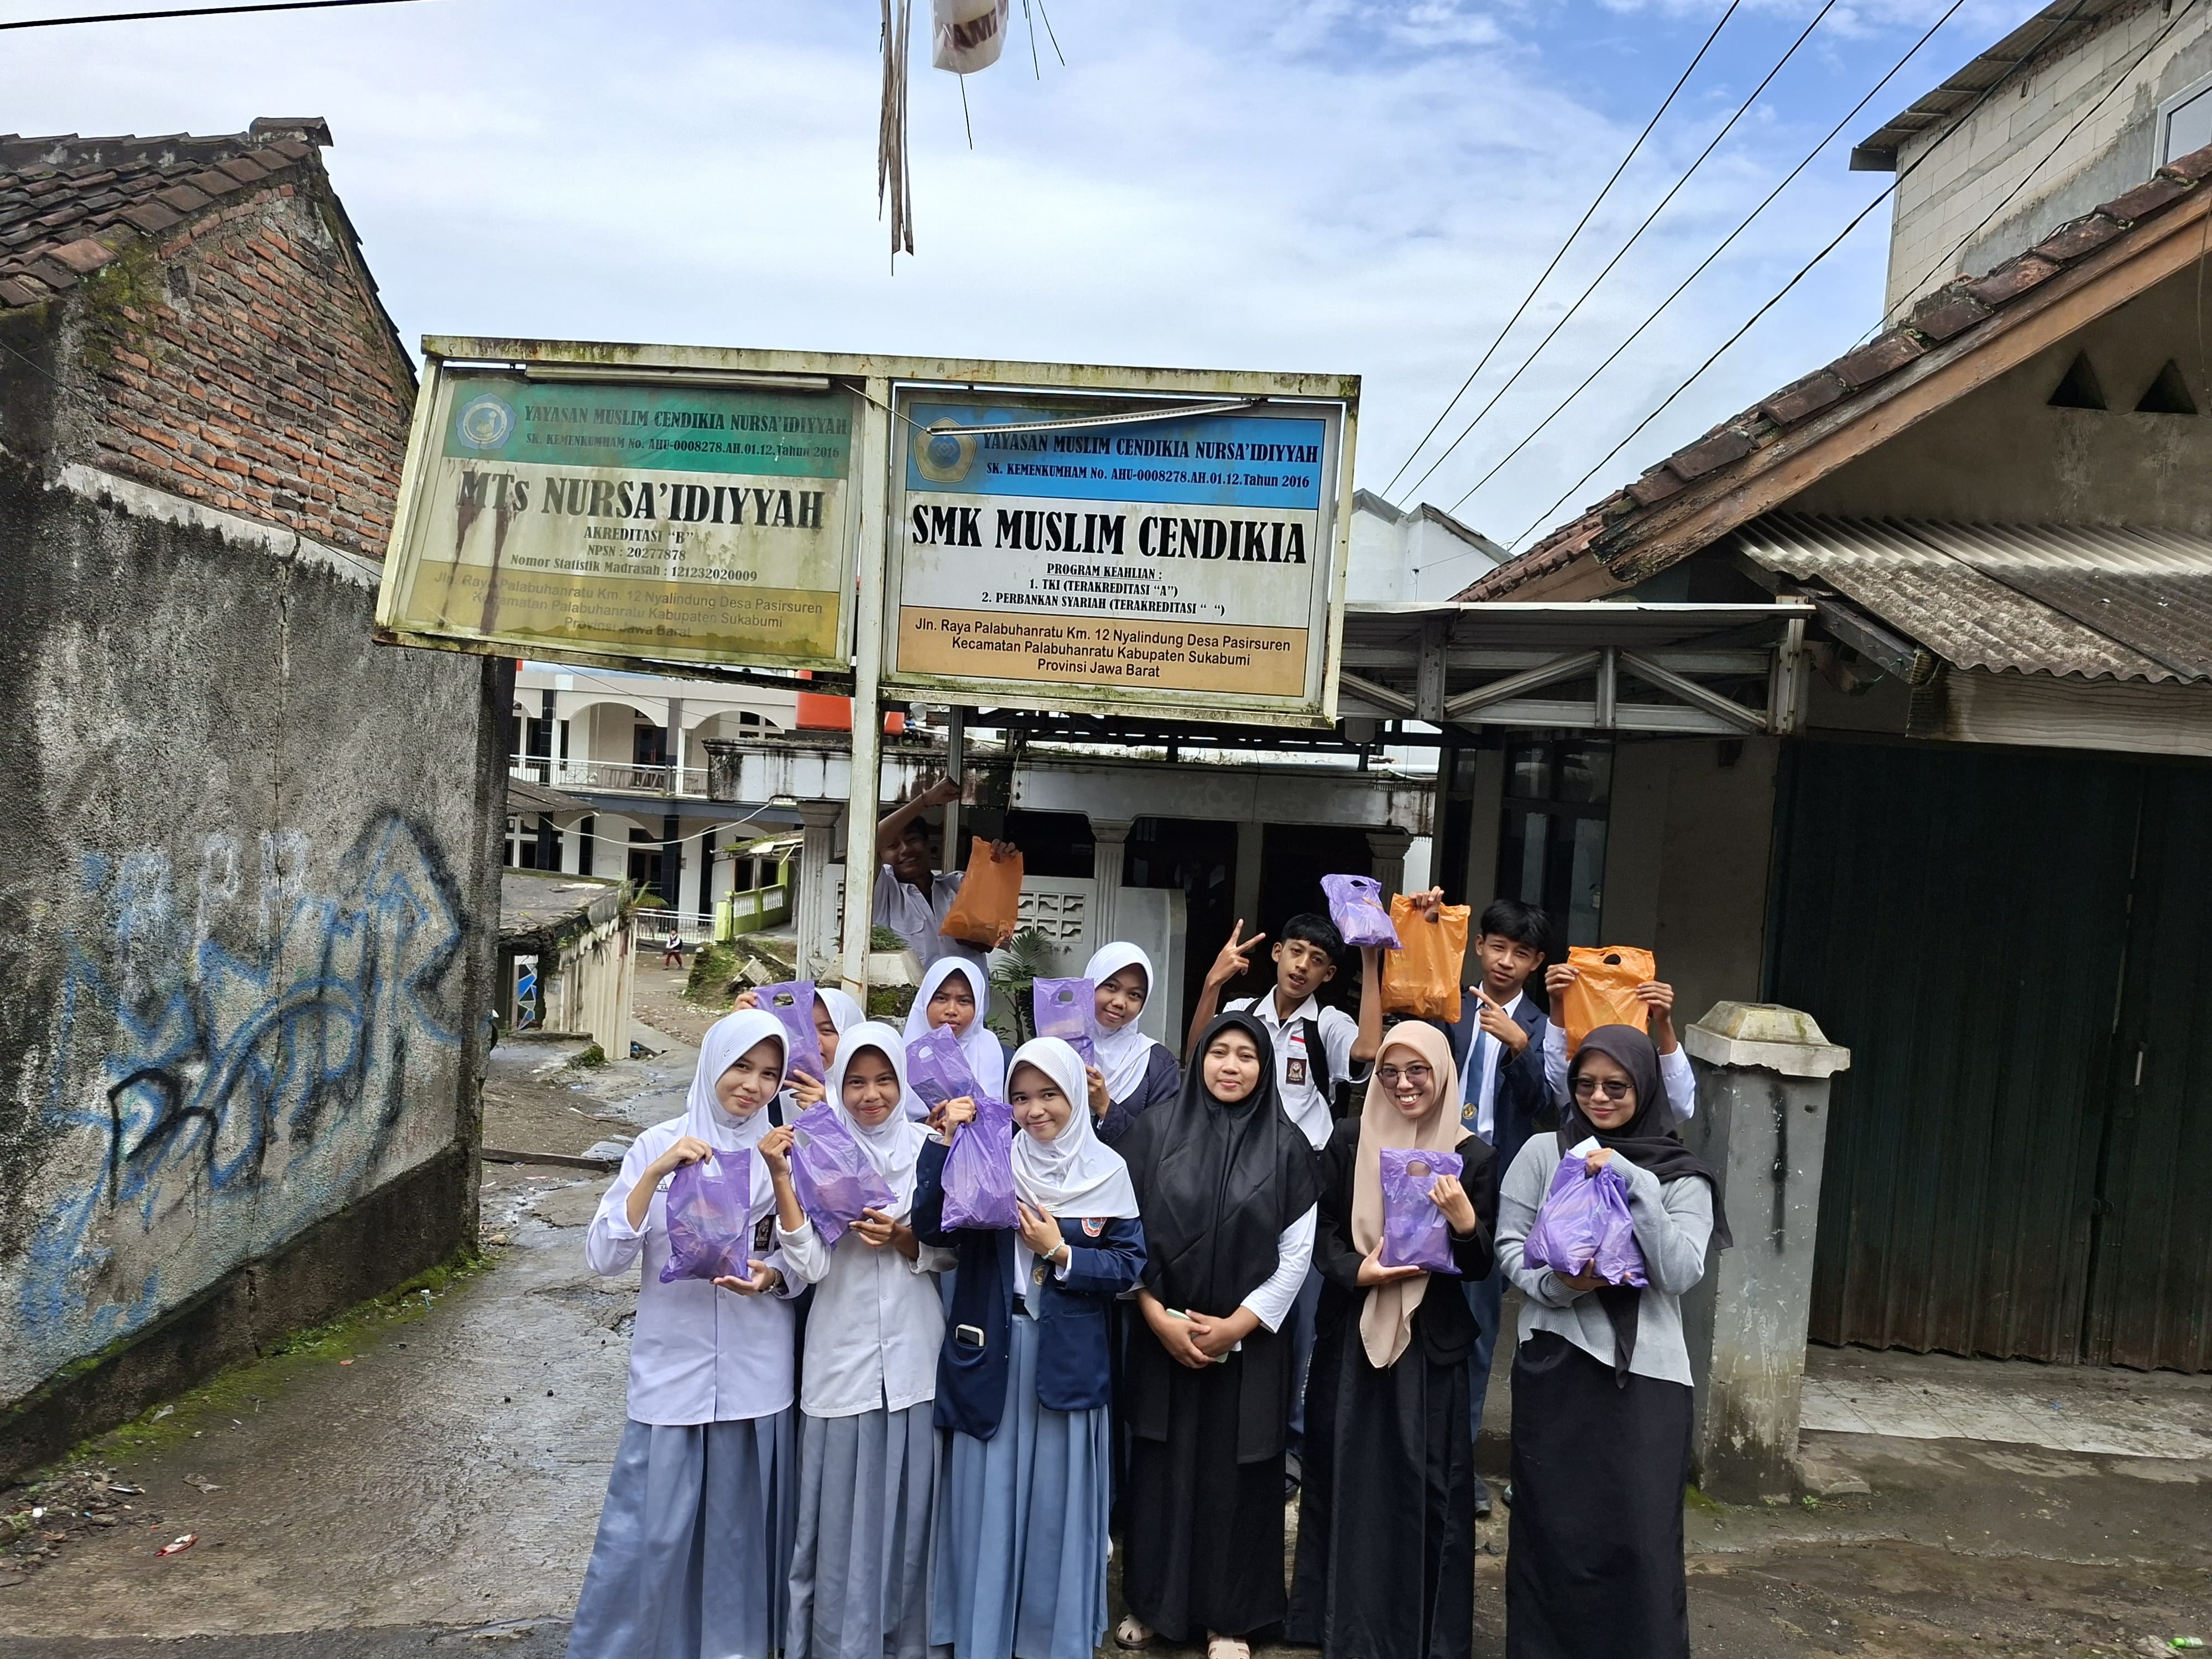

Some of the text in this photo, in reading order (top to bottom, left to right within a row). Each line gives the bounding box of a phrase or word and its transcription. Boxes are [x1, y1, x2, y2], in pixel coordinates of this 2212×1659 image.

[525, 405, 588, 424] YAYASAN
[592, 409, 649, 426] MUSLIM
[654, 411, 725, 430] CENDIKIA
[526, 433, 542, 444] SK.
[628, 438, 644, 449] No.
[814, 446, 839, 458] 2016
[983, 433, 1047, 452] YAYASAN
[1053, 435, 1111, 455] MUSLIM
[1116, 438, 1190, 458] CENDIKIA
[987, 462, 1003, 474] SK.
[1007, 463, 1087, 479] KEMENKUMHAM
[1090, 467, 1108, 479] No.
[1282, 476, 1310, 488] 2016
[457, 471, 529, 512] MTs
[584, 526, 662, 543] AKREDITASI
[912, 504, 1307, 564] SMK MUSLIM CENDIKIA
[587, 544, 615, 557] NPSN
[627, 547, 686, 561] 20277878
[510, 554, 550, 568] Nomor
[554, 557, 600, 572] Statistik
[604, 561, 660, 576] Madrasah
[671, 566, 758, 582] 121232020009
[1046, 563, 1100, 576] PROGRAM
[1104, 566, 1155, 580] KEAHLIAN
[500, 578, 593, 598] Palabuhanratu
[598, 587, 622, 601] Km.
[627, 591, 642, 602] 12
[645, 591, 716, 609] Nyalindung
[720, 596, 752, 609] Desa
[755, 598, 823, 614] Pasirsuren
[1029, 578, 1038, 589] 1.
[1042, 579, 1061, 591] TKI
[1063, 580, 1150, 596] (TERAKREDITASI
[552, 600, 644, 618] Palabuhanratu
[649, 608, 717, 625] Kabupaten
[721, 612, 782, 628] Sukabumi
[982, 592, 992, 603] 2.
[995, 592, 1058, 607] PERBANKAN
[1061, 596, 1107, 609] SYARIAH
[1109, 599, 1197, 614] (TERAKREDITASI
[619, 621, 653, 635] Jawa
[915, 618, 1290, 651] Jln. Raya Palabuhanratu Km. 12 Nyalindung Desa Pasirsuren
[952, 637, 1250, 666] Kecamatan Palabuhanratu Kabupaten Sukabumi
[1037, 658, 1160, 677] Provinsi Jawa Barat
